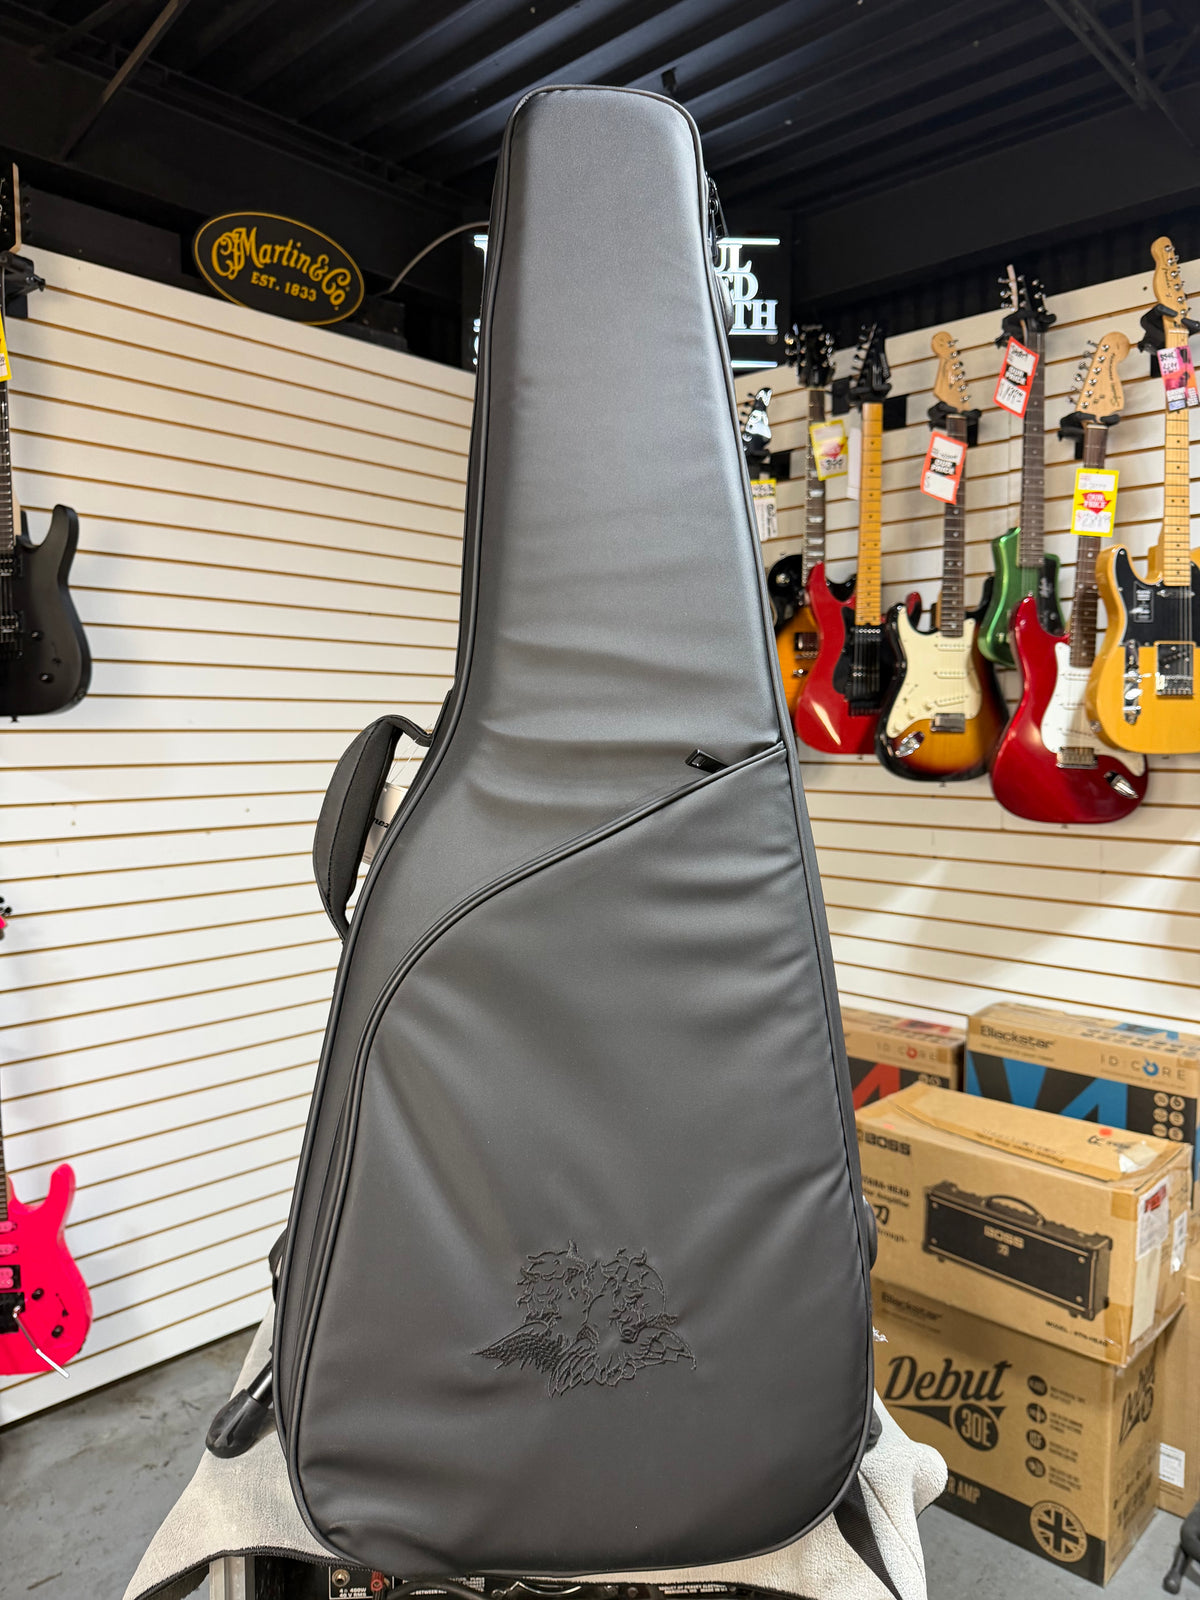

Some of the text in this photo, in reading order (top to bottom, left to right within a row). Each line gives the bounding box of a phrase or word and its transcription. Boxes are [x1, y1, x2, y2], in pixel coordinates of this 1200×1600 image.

[251, 271, 317, 302] EST. 1833
[864, 1131, 912, 1157] BOSS
[884, 1355, 1013, 1402] Debut
[961, 1408, 993, 1448] 30E
